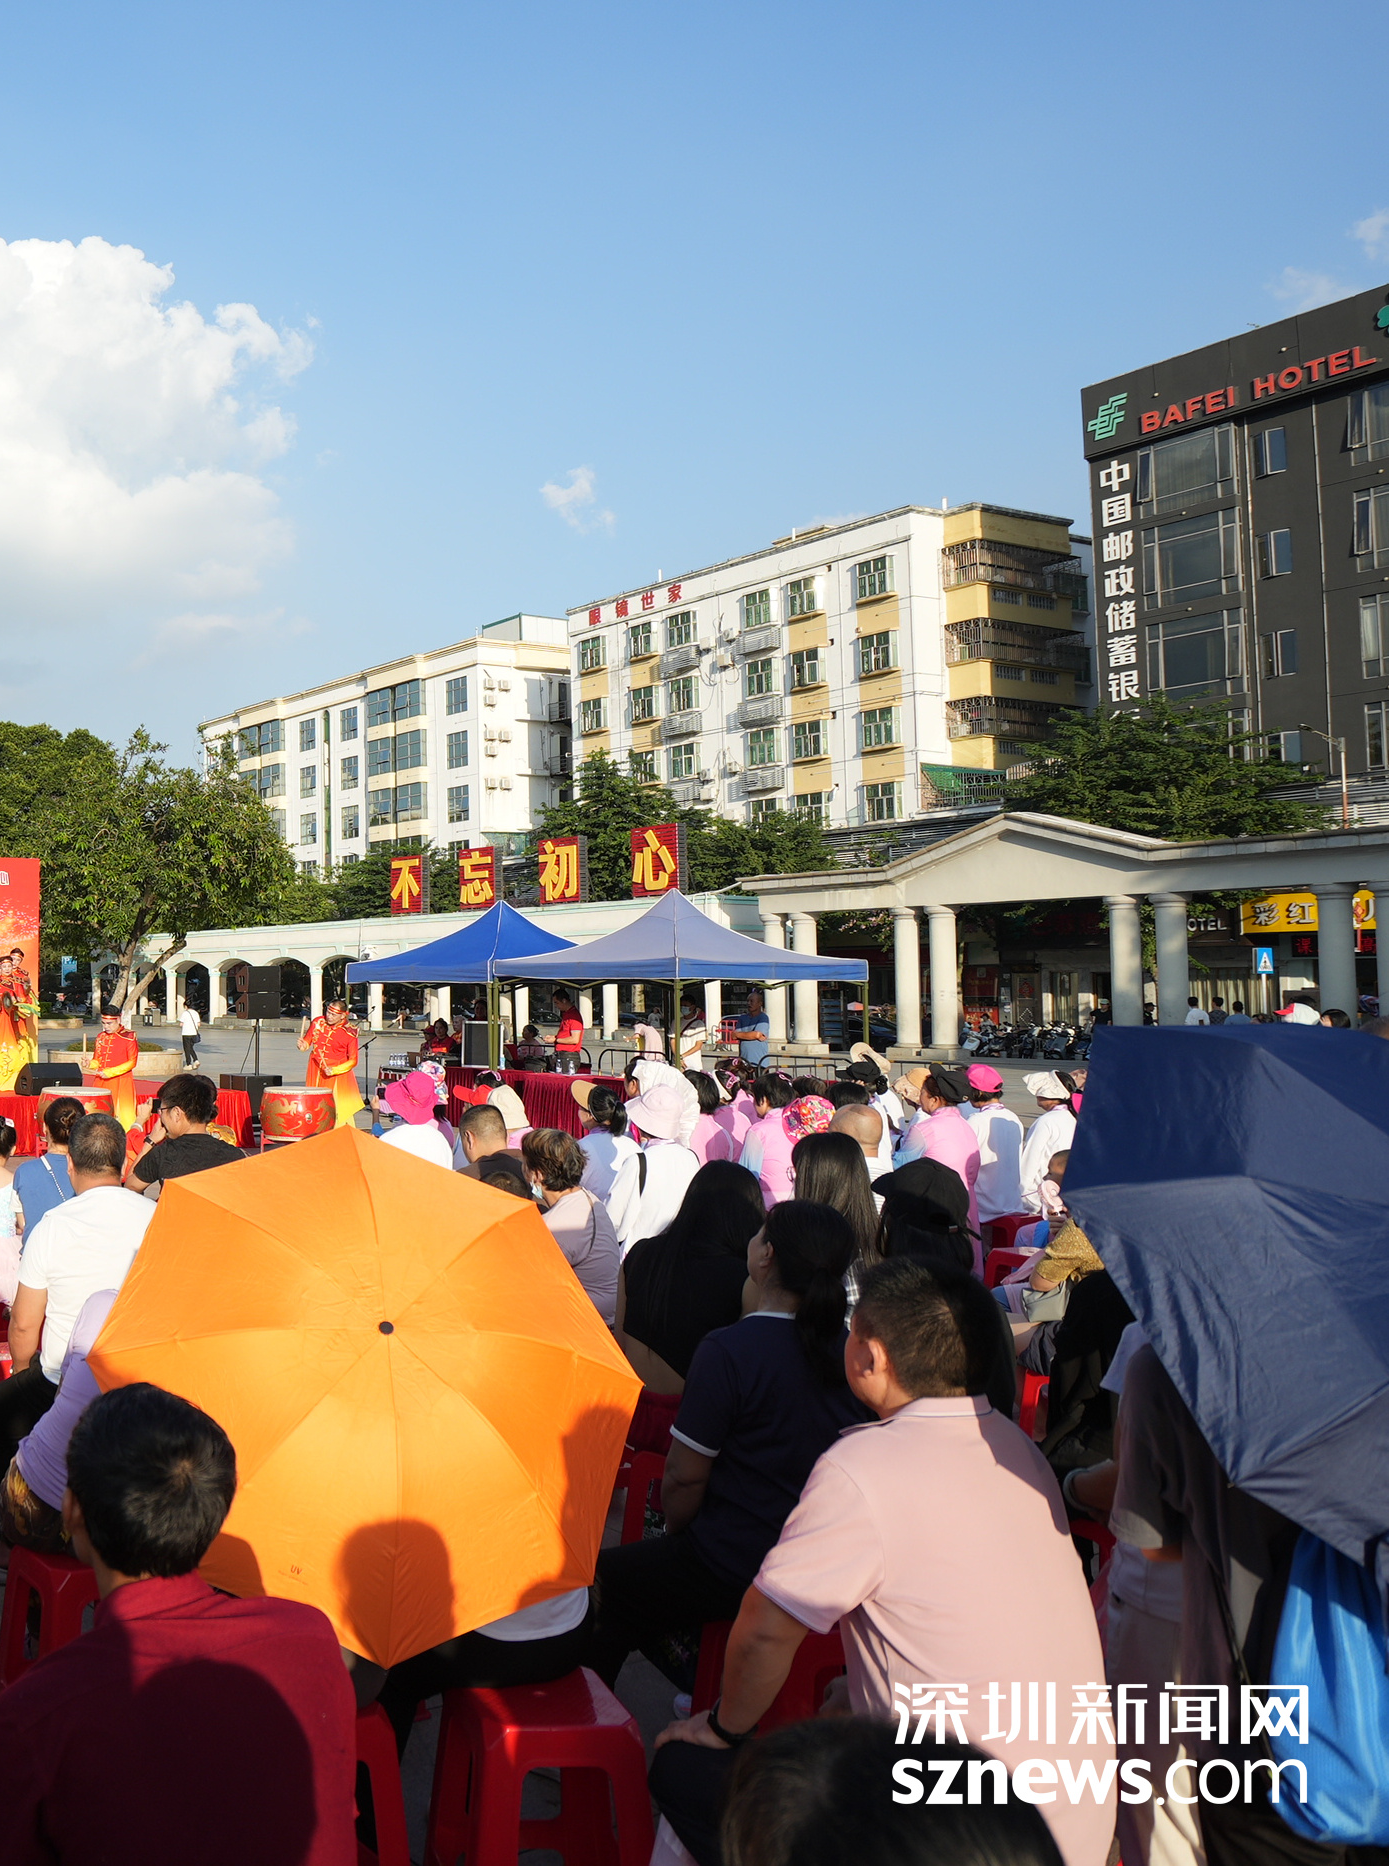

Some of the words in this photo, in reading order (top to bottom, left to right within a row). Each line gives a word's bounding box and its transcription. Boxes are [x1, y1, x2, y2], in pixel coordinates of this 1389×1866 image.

[1140, 385, 1236, 435] BAFEI
[1252, 345, 1377, 400] HOTEL
[588, 583, 682, 626] 眼镜世家
[390, 829, 676, 909] 不忘初心
[1186, 917, 1228, 932] OTEL
[290, 1564, 303, 1576] UV
